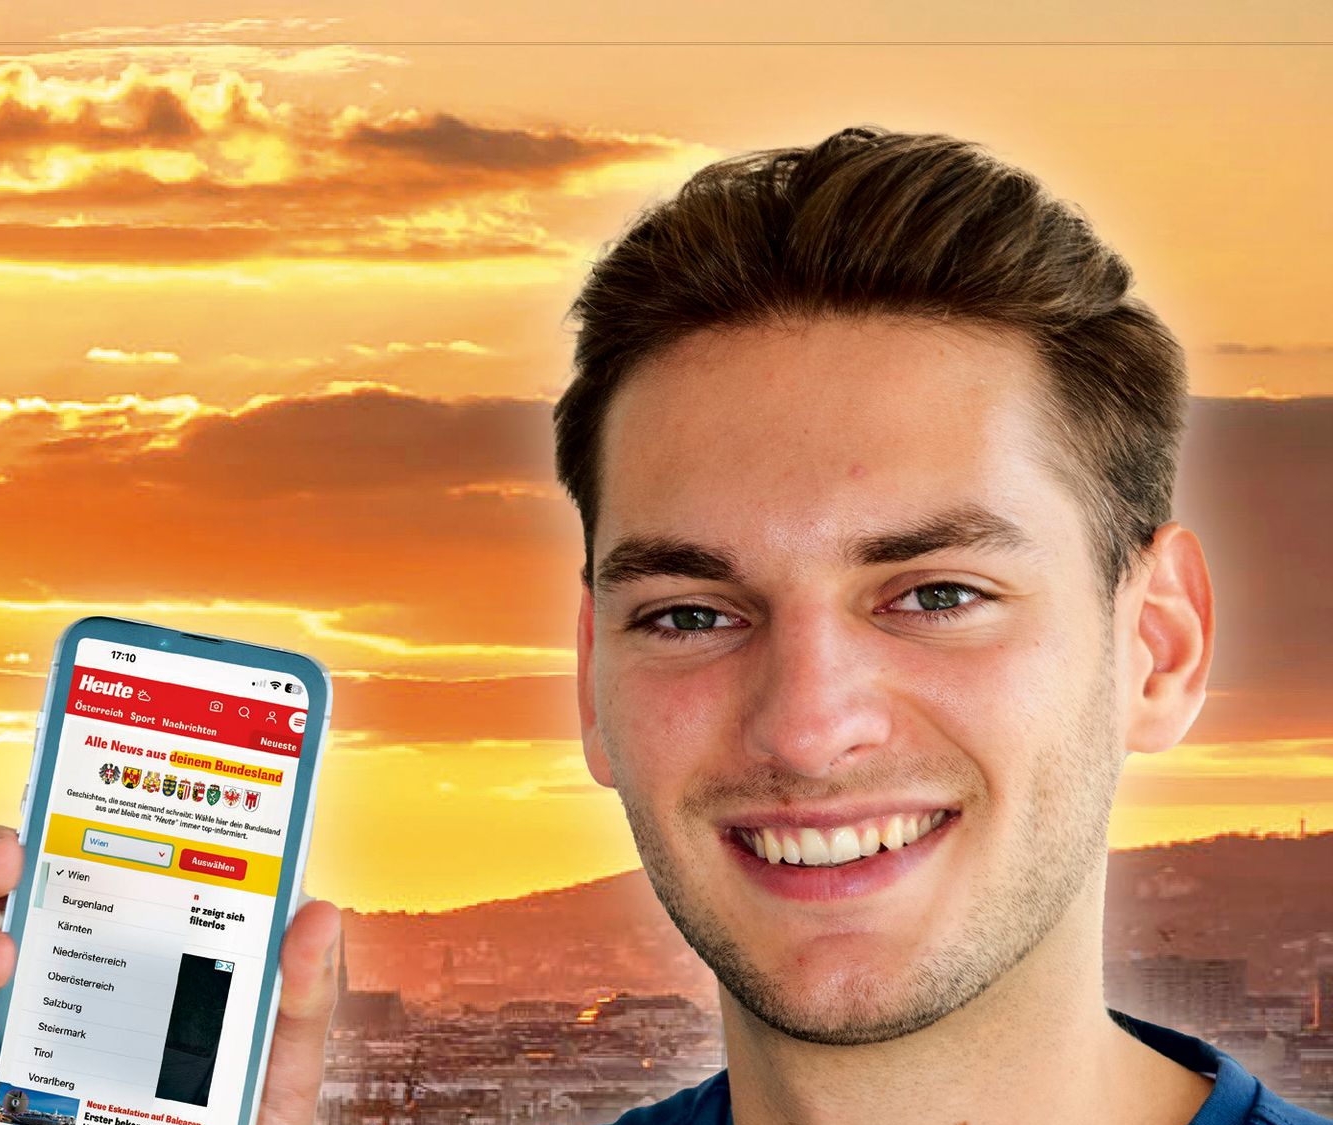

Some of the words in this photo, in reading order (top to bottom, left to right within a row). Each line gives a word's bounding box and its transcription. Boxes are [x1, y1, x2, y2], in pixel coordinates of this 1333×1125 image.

[111, 650, 137, 663] 17:10
[79, 674, 134, 699] Heute
[74, 700, 124, 718] Österreich
[130, 711, 156, 725] Sport
[162, 718, 218, 736] Nachrichten
[260, 737, 297, 752] Neueste
[85, 735, 108, 749] Alle
[110, 740, 144, 756] News
[146, 749, 167, 760] aus
[169, 752, 212, 769] deinem
[215, 759, 284, 783] Bundesland
[67, 788, 107, 803] Geschichten,
[119, 800, 137, 809] sonst
[137, 803, 165, 813] niemand
[195, 813, 215, 823] Wähle
[215, 816, 229, 826] hier
[229, 820, 243, 829] dein
[244, 822, 281, 836] Bundesland
[108, 807, 120, 815] und
[120, 808, 140, 818] bleibe
[140, 812, 152, 821] mit
[179, 820, 201, 830] immer
[201, 825, 249, 840] top-informiert.
[89, 838, 109, 848] Wien
[191, 856, 235, 873] Auswählen
[68, 870, 90, 882] Wien
[62, 895, 114, 913] Burgenland
[189, 915, 226, 931] filterlos
[190, 906, 201, 914] er
[202, 908, 225, 920] zeigt
[226, 912, 245, 922] sich
[57, 920, 93, 935] Kärnten
[52, 946, 127, 968] Niederösterreich
[47, 971, 115, 992] Oberösterreich
[42, 996, 83, 1014] Salzburg
[37, 1021, 87, 1039] Steiermark
[33, 1046, 54, 1059] Tirol
[28, 1072, 76, 1091] Vorarlberg
[84, 1112, 114, 1125] Erster
[86, 1100, 107, 1111] Neue
[108, 1104, 150, 1119] Eskalation
[150, 1113, 165, 1121] auf
